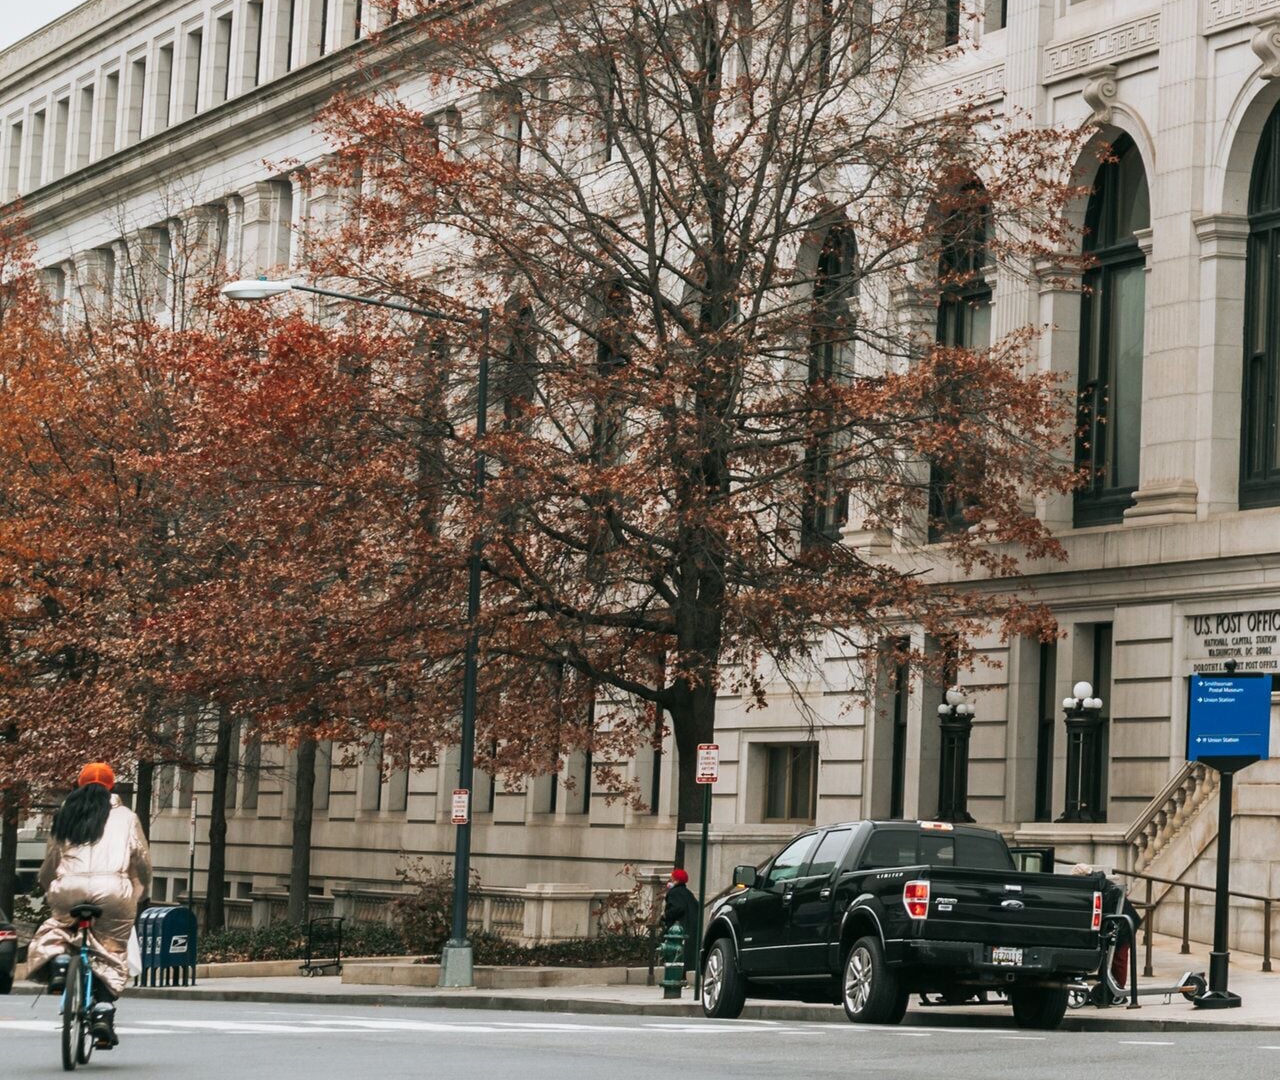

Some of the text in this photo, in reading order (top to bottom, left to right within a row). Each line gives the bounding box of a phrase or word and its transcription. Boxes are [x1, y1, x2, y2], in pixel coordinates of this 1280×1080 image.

[1194, 615, 1213, 636] U.S.
[1216, 613, 1243, 634] POST
[1204, 635, 1277, 647] NATIONAL CAPITAL STATION
[1245, 661, 1258, 670] POST
[1259, 660, 1278, 669] OFFICE
